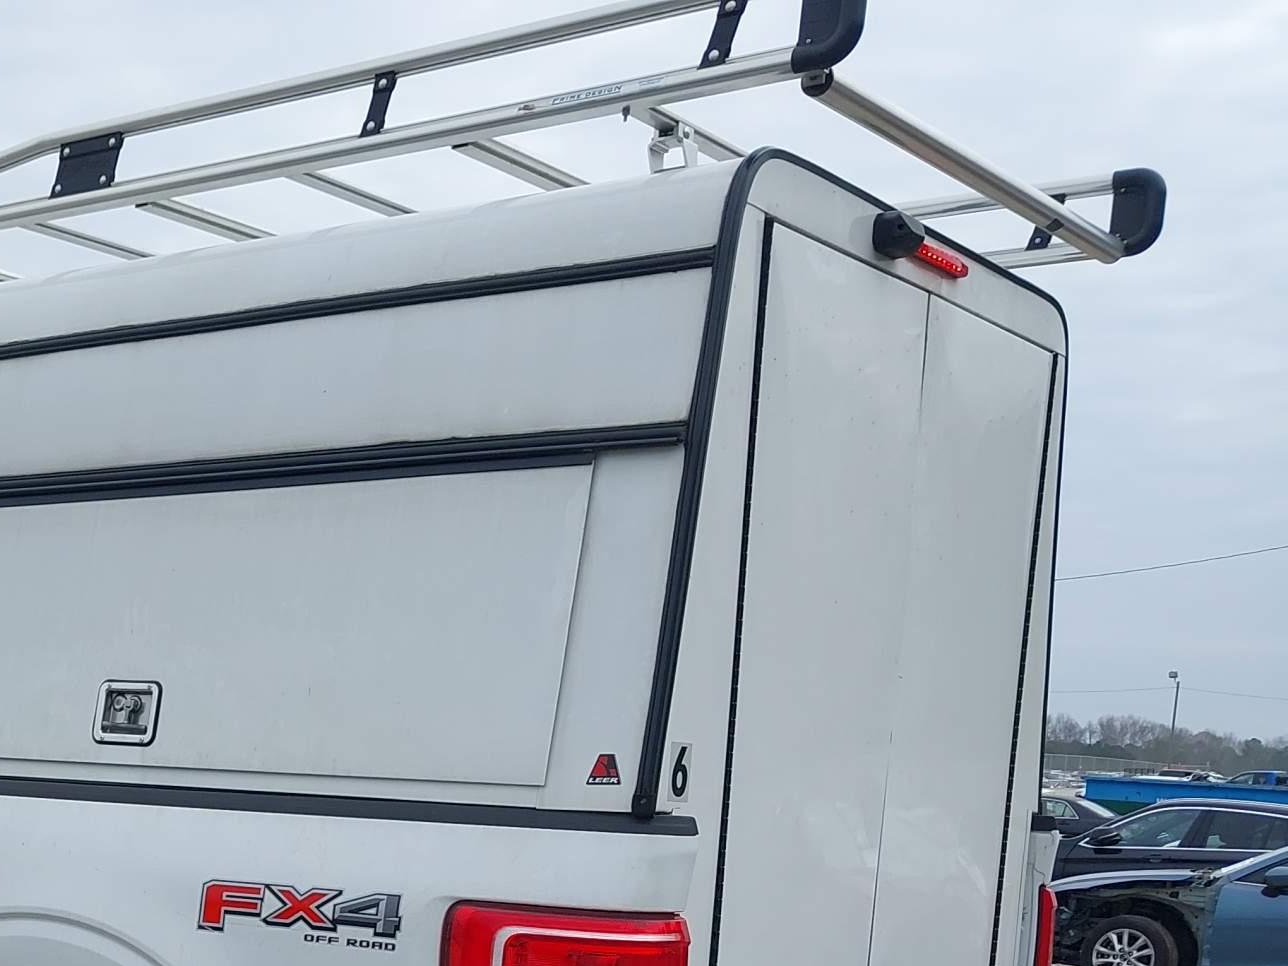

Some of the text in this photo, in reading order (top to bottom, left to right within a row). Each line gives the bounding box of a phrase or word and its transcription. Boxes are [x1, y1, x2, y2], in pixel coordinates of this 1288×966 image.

[672, 746, 688, 797] 6
[197, 879, 402, 938] FX4
[303, 933, 397, 951] OFF ROAD
